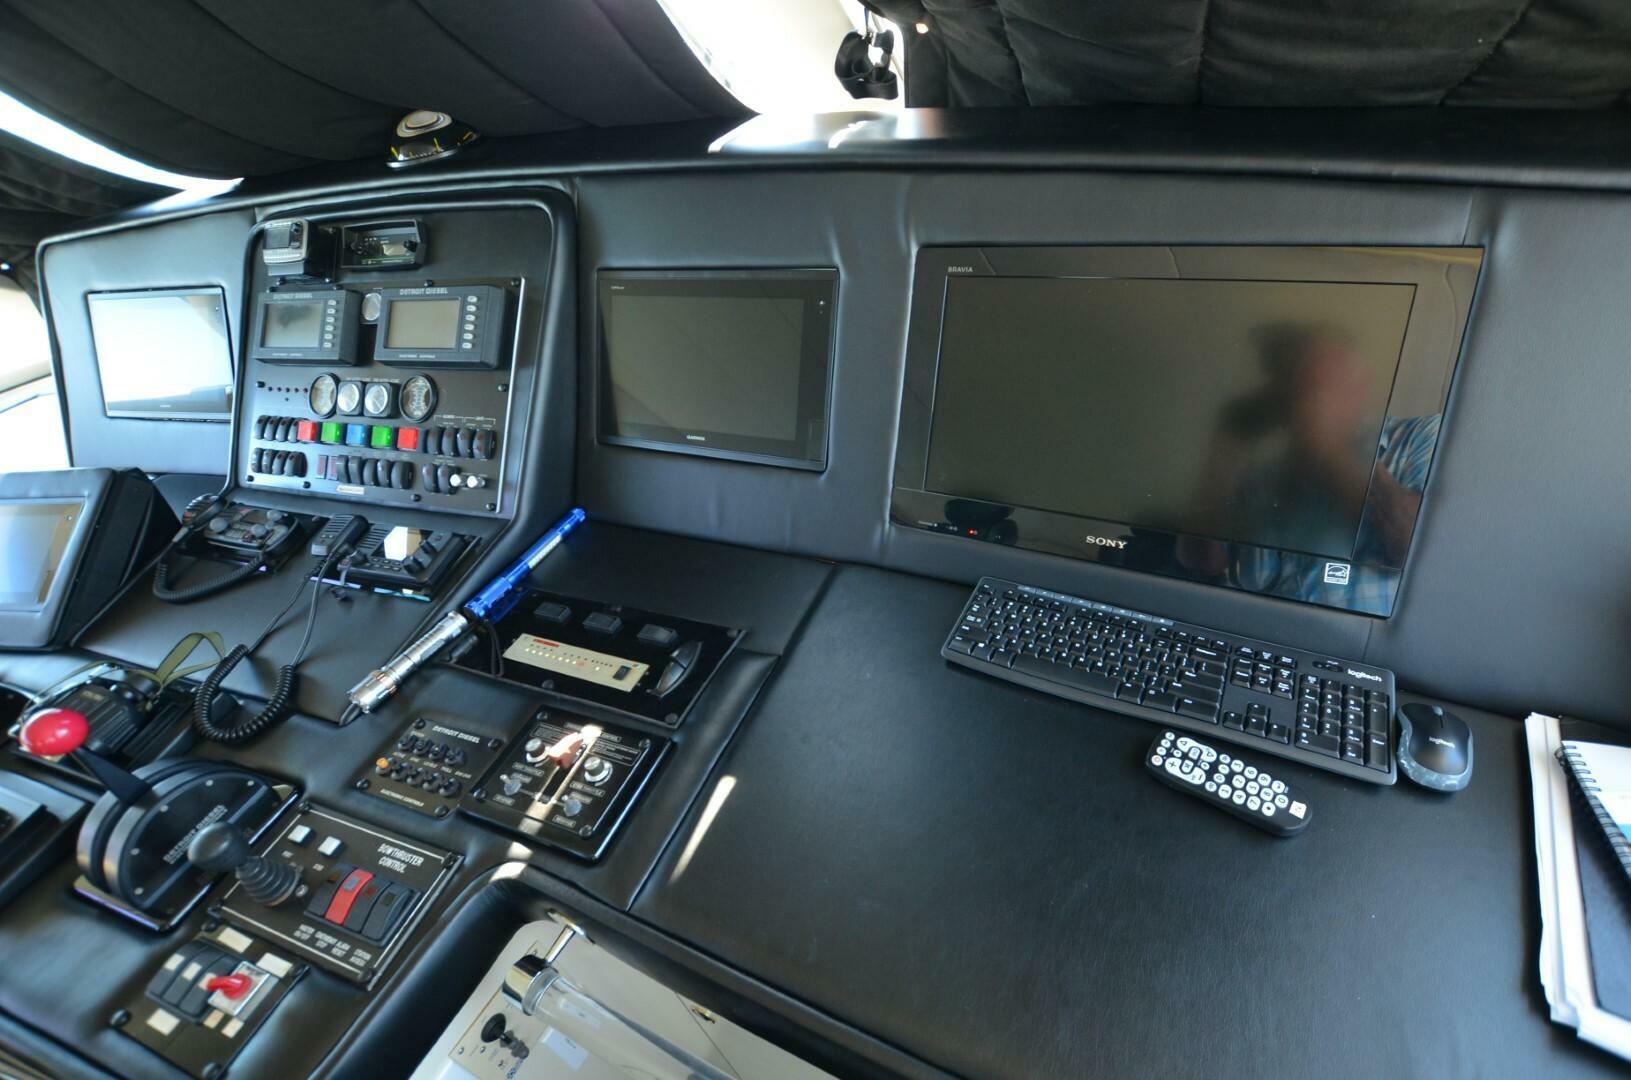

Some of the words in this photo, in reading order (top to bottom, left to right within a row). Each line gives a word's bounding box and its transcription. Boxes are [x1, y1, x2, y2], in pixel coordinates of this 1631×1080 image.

[1086, 535, 1128, 549] SONY
[1347, 668, 1382, 682] logitech
[378, 843, 424, 867] BOWTHRUSTER
[378, 856, 408, 873] CONTROL
